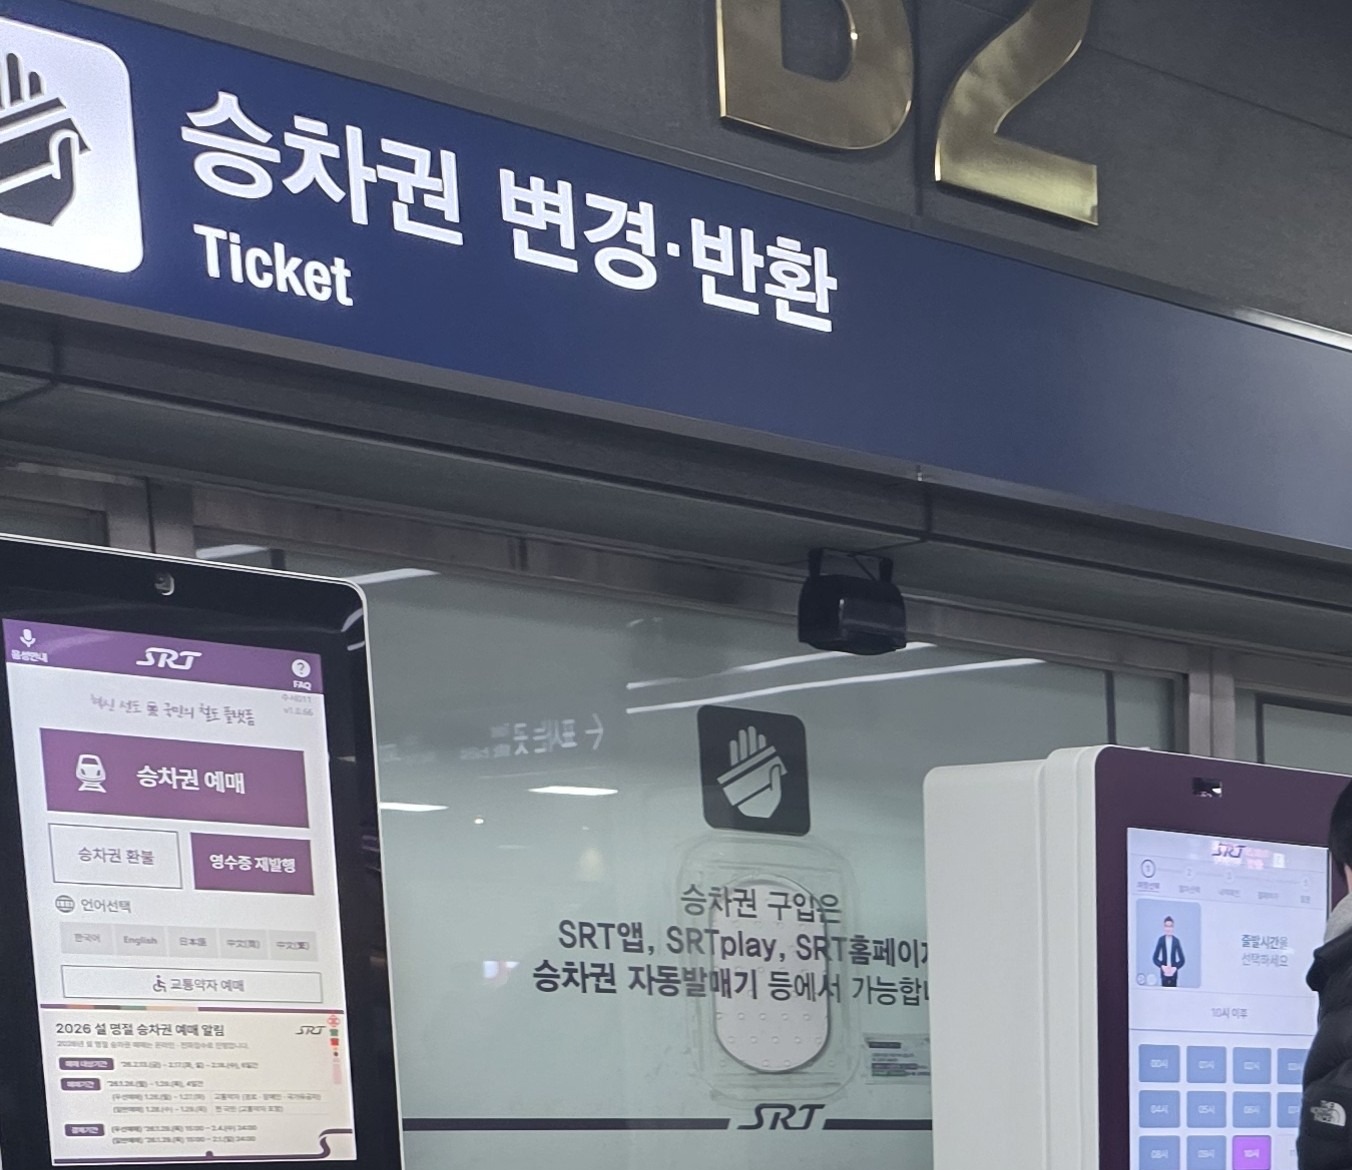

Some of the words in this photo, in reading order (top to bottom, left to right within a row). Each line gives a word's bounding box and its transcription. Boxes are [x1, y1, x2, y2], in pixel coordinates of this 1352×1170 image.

[180, 91, 465, 246] 승차권
[499, 167, 838, 332] 변경·반환
[193, 224, 354, 307] Ticket
[136, 647, 202, 670] SRT
[293, 680, 312, 691] FAQ
[120, 700, 142, 714] 선도
[163, 703, 194, 719] 국민의
[199, 703, 220, 723] 철도
[223, 706, 255, 726] 플랫폼
[136, 766, 199, 790] 승차권
[204, 771, 245, 794] 예매
[78, 847, 122, 864] 승차권
[125, 849, 155, 865] 환불
[209, 854, 252, 871] 영수증
[254, 856, 296, 873] 재발행
[81, 898, 132, 914] 언어선택
[681, 884, 758, 920] 승차권
[767, 891, 842, 924] 구입은
[123, 936, 158, 946] English
[558, 919, 656, 954] SRT앱,
[666, 926, 786, 964] SRTplay,
[1241, 934, 1288, 950] 출발시간을
[171, 978, 217, 993] 교통약자
[221, 980, 245, 993] 예매
[533, 959, 617, 994] 승차권
[628, 964, 758, 999] 자동발매기
[768, 972, 841, 1003] 등에서
[56, 1023, 91, 1034] 2026
[95, 1023, 107, 1036] 설
[110, 1023, 134, 1036] 명절
[137, 1024, 172, 1036] 승차권
[175, 1024, 199, 1036] 예매
[201, 1024, 224, 1036] 알림
[295, 1025, 326, 1035] SRT
[737, 1103, 826, 1131] SRT
